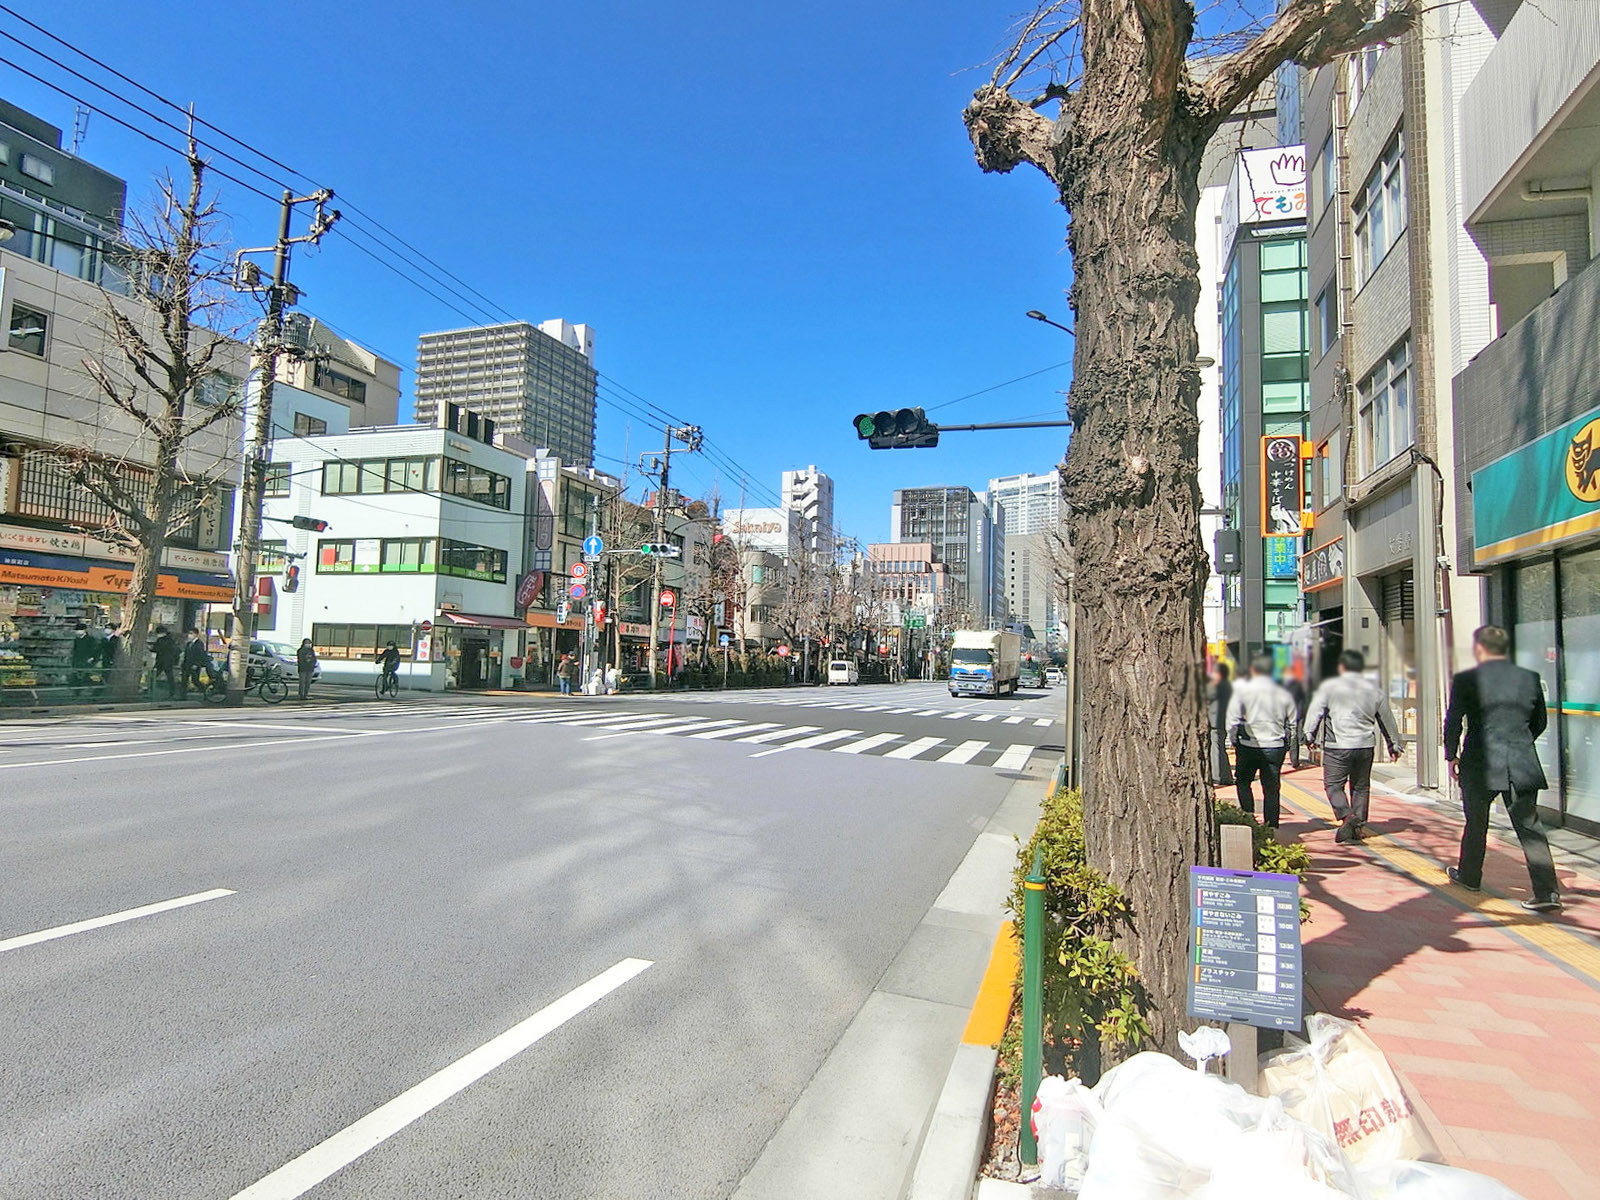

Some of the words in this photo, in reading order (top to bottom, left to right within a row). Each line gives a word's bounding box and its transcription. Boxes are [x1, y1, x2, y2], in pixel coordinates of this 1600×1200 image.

[1284, 462, 1295, 490] つけめん
[1270, 470, 1283, 504] 中華そば
[1, 570, 56, 582] Matsumoto
[57, 575, 88, 585] KiYoshi
[1201, 967, 1236, 977] プラスチック
